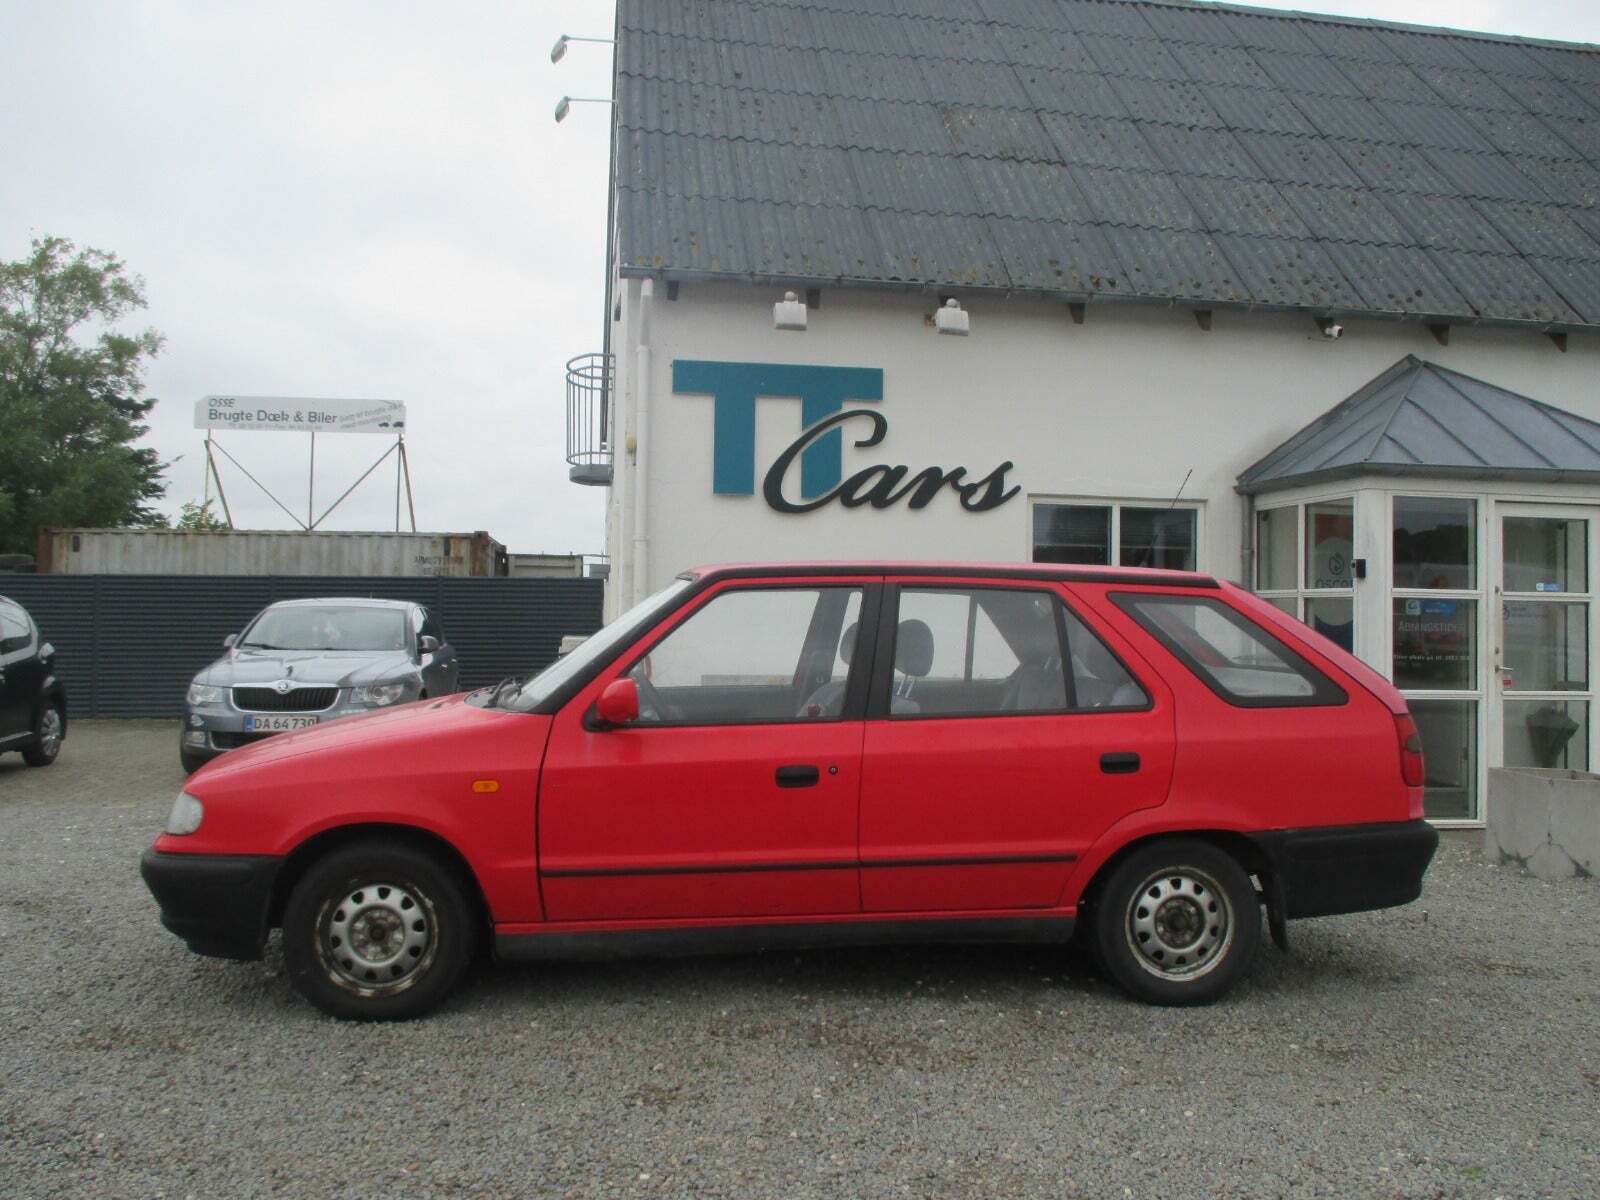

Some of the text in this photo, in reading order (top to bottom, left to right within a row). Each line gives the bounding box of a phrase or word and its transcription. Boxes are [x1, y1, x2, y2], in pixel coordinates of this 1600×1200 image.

[208, 408, 253, 423] Brugte
[293, 410, 304, 423] &
[308, 411, 337, 424] Biler
[763, 409, 1021, 513] Cars
[254, 718, 270, 729] DA
[273, 718, 289, 729] 64
